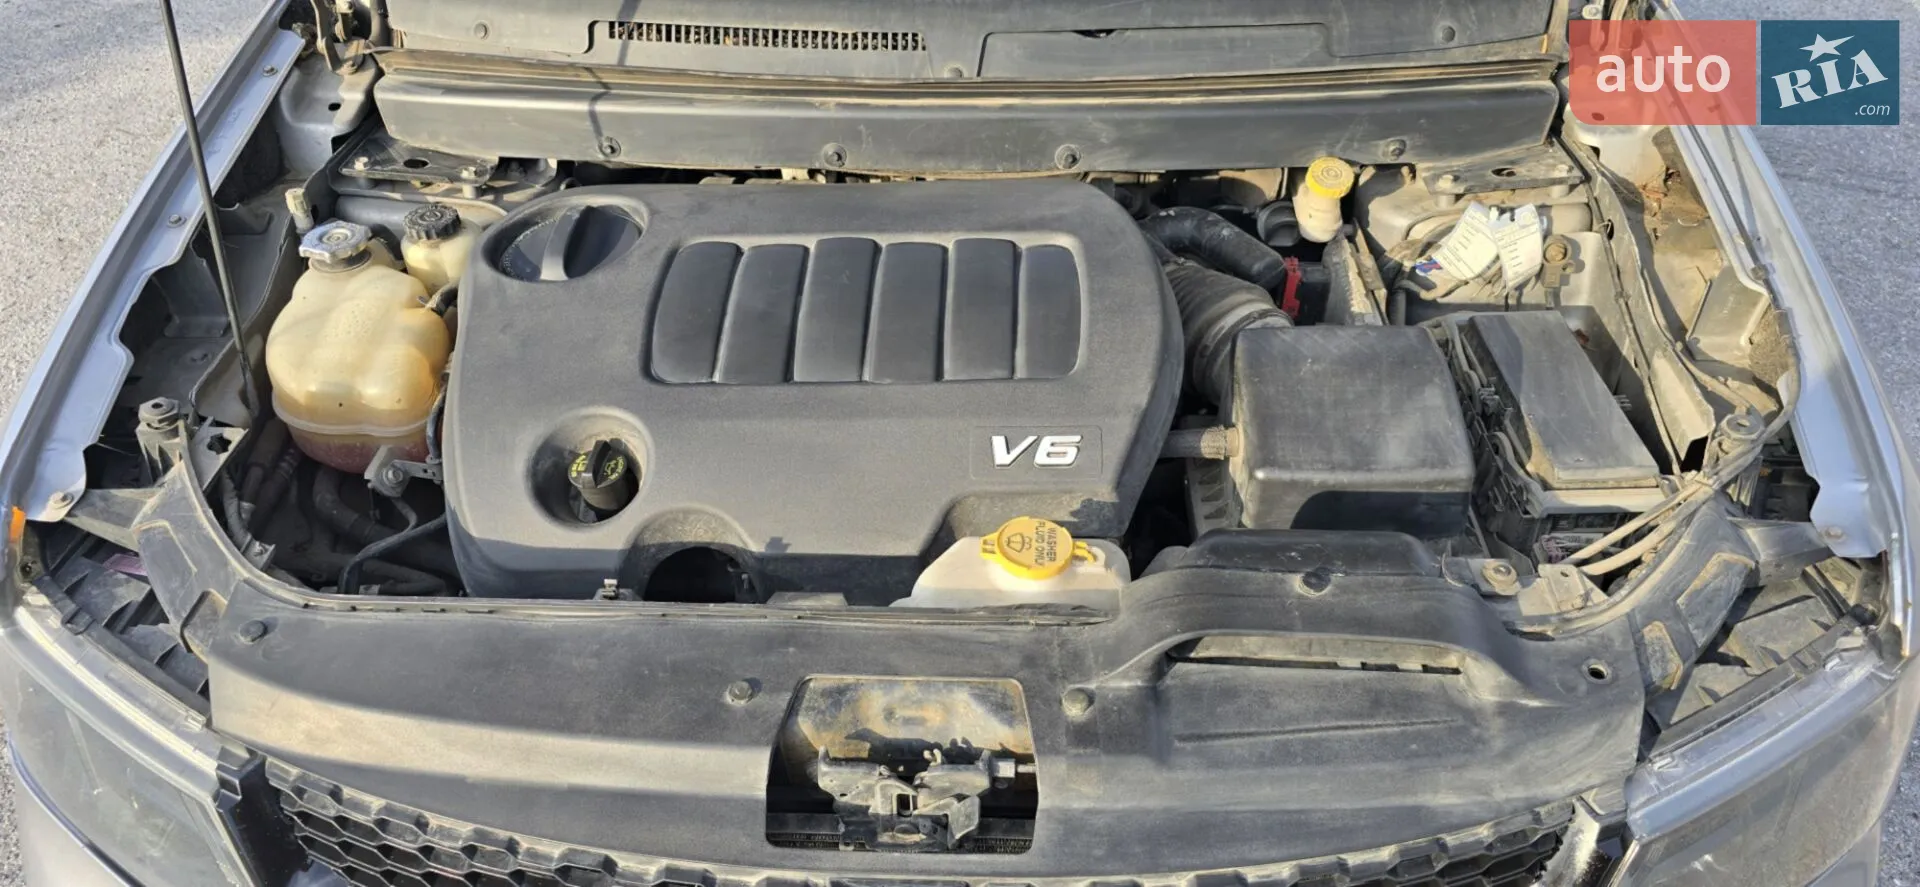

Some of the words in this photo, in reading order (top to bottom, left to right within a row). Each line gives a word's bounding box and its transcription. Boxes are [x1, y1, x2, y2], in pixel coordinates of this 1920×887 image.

[990, 435, 1083, 468] V6
[1035, 520, 1046, 544] FLUID
[1046, 527, 1058, 562] WASHER
[1034, 545, 1046, 567] ONLY
